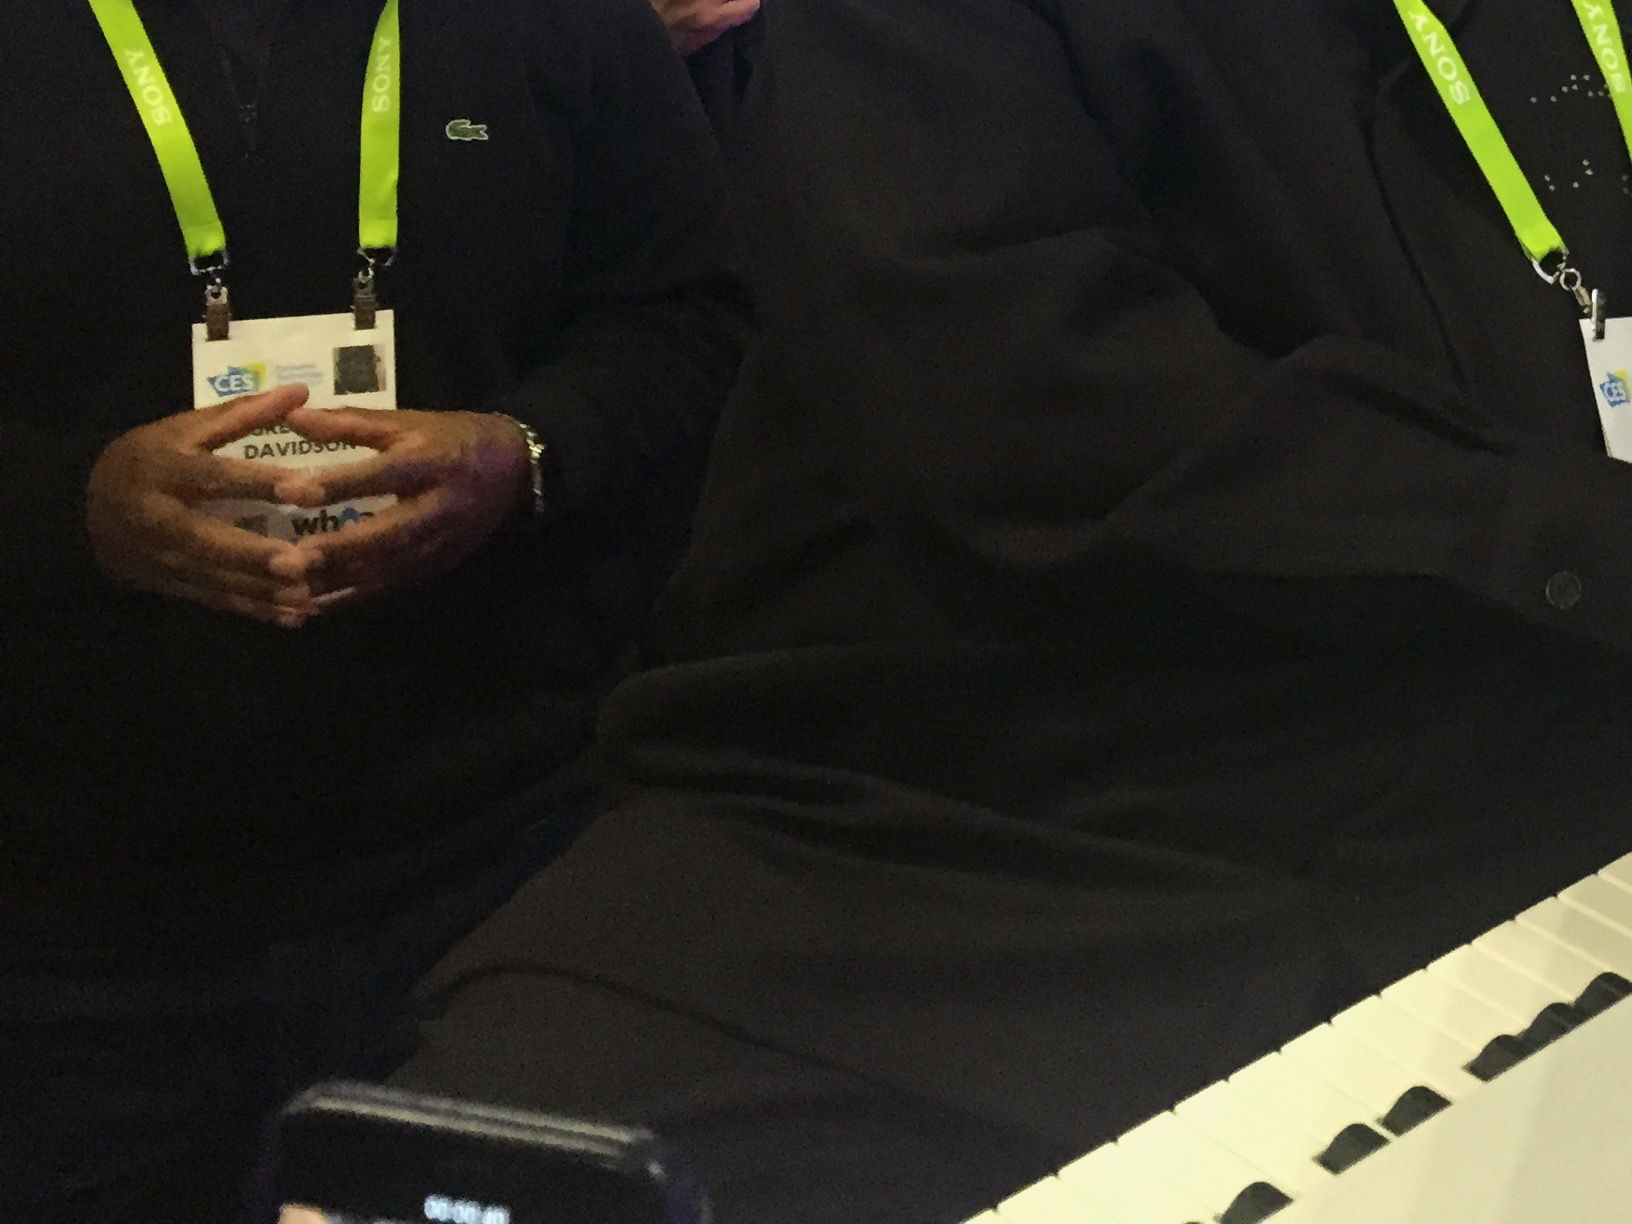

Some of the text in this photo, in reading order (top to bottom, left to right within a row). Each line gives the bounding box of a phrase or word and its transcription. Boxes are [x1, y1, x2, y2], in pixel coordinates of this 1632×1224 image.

[371, 36, 391, 113] SONY
[1407, 10, 1471, 105] SONY
[1582, 1, 1626, 93] SONY
[124, 48, 172, 126] SONY
[214, 374, 255, 392] CES
